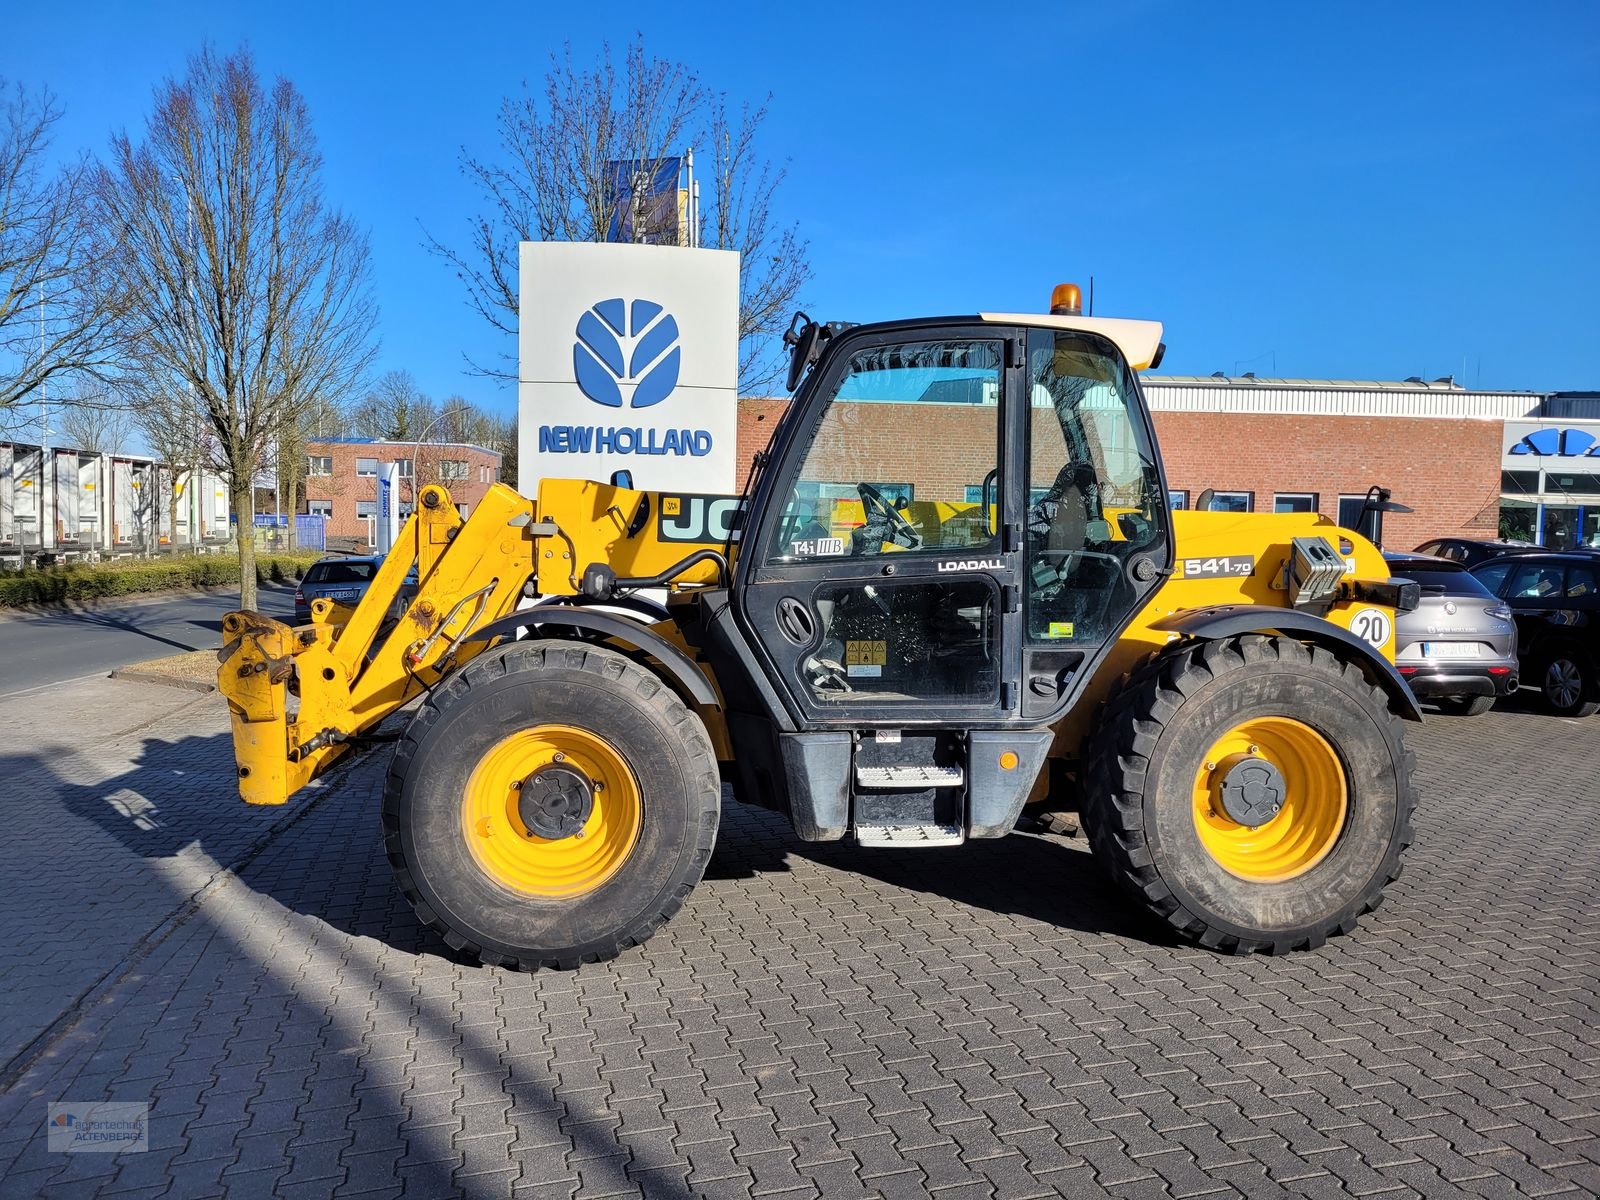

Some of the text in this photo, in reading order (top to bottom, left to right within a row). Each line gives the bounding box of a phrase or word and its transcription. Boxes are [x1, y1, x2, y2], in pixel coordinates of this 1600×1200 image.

[538, 425, 713, 457] NEW HOLLAND
[662, 498, 748, 541] JC
[791, 540, 816, 555] T4i
[938, 559, 1005, 572] LOADALL
[1358, 616, 1383, 643] 20
